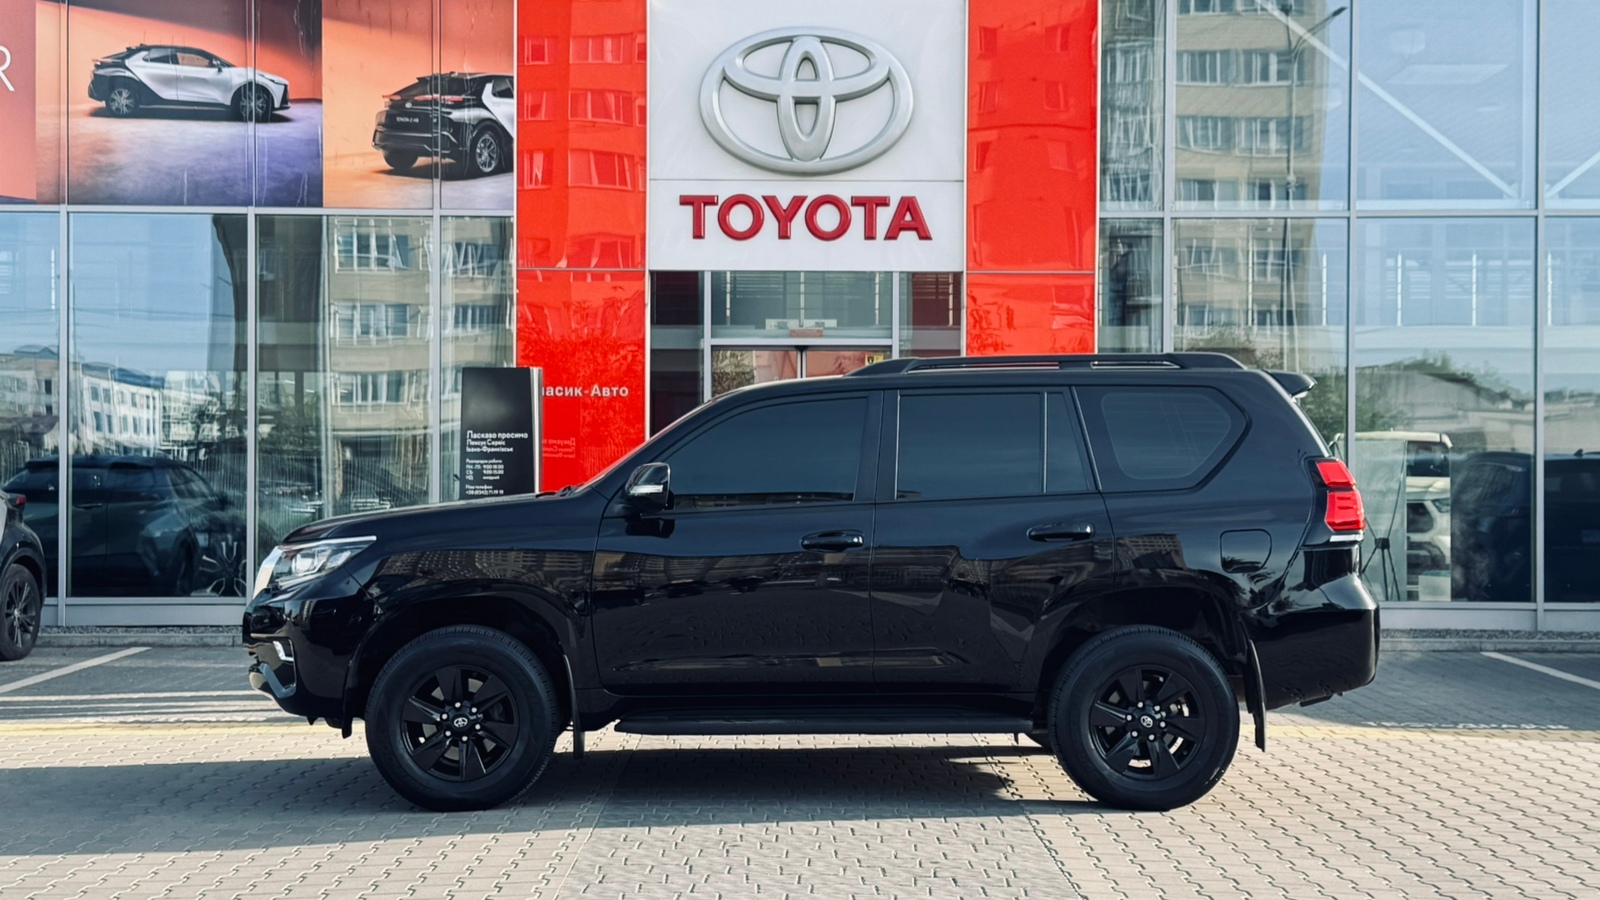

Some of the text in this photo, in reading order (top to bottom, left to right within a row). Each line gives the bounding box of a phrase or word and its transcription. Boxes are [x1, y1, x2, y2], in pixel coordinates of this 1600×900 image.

[679, 193, 933, 241] TOYOTA
[467, 430, 528, 440] Ласкаво просимо
